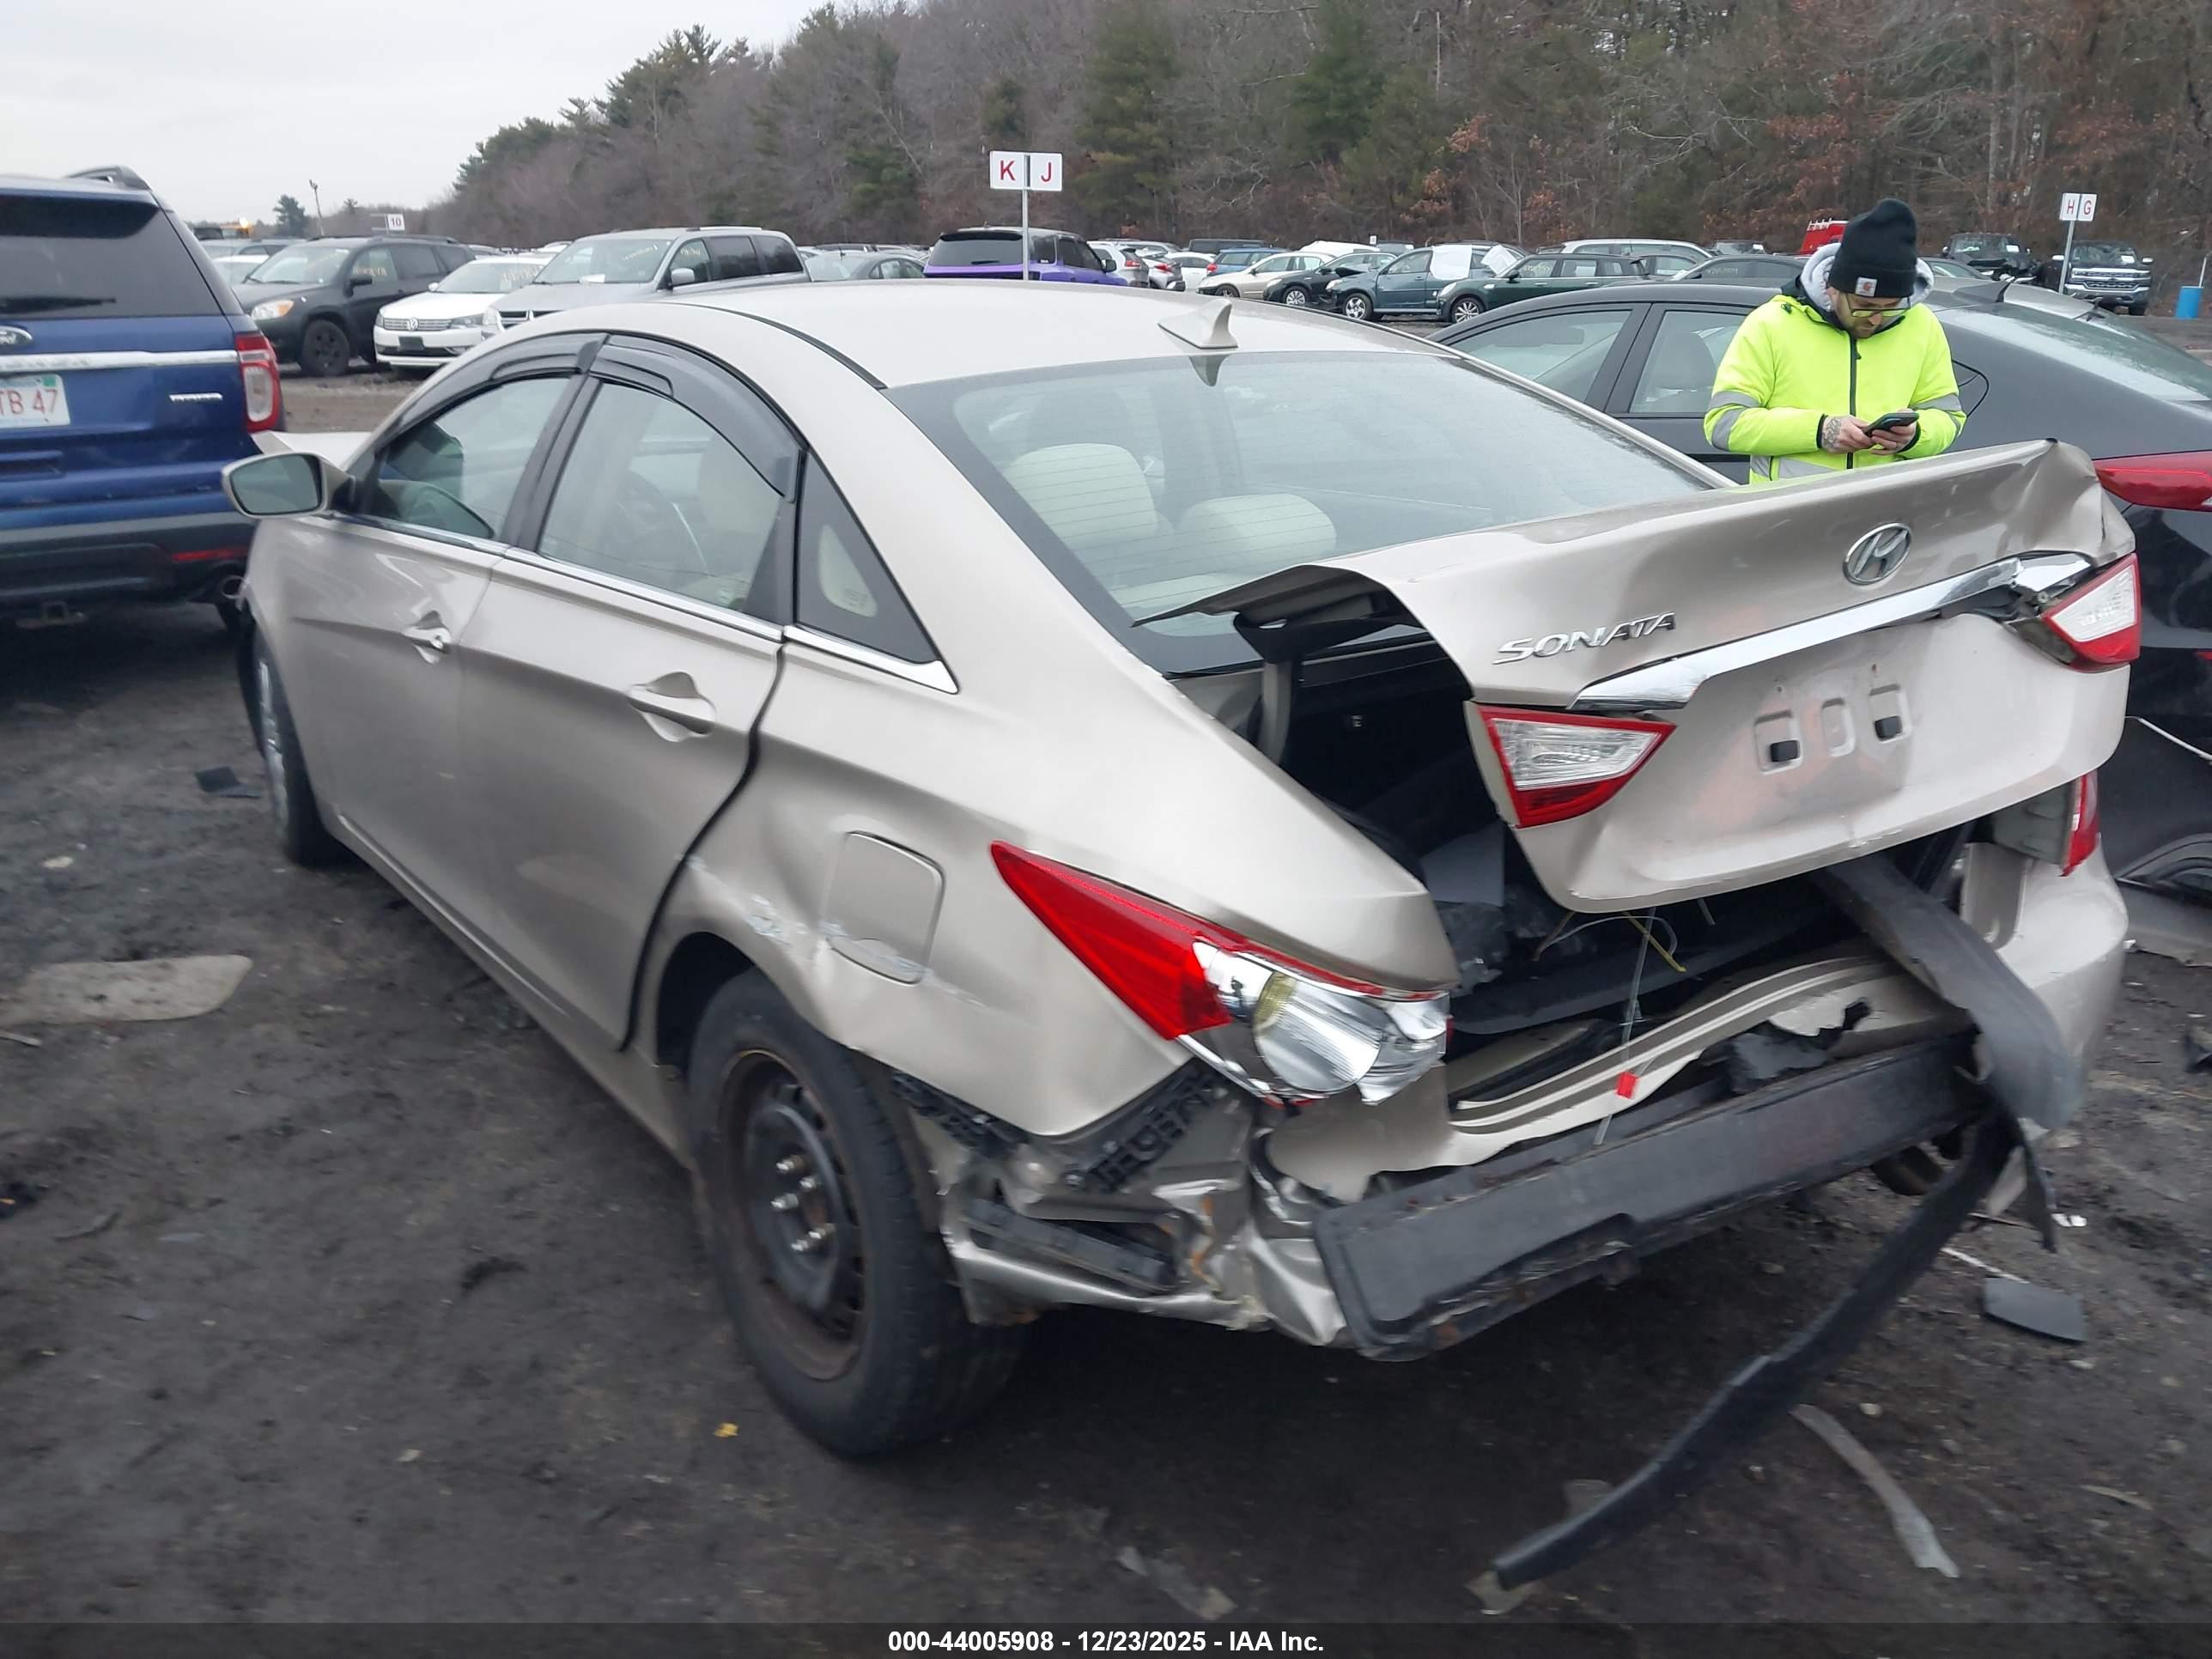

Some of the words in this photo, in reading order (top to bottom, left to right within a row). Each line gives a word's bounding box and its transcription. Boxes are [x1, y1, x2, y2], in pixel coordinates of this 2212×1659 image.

[1000, 160, 1016, 181] K
[1040, 161, 1052, 183] J
[2066, 198, 2075, 216] H
[2083, 199, 2093, 216] G
[390, 217, 403, 228] 10
[33, 388, 58, 414] 47
[1492, 611, 1675, 665] SONATA
